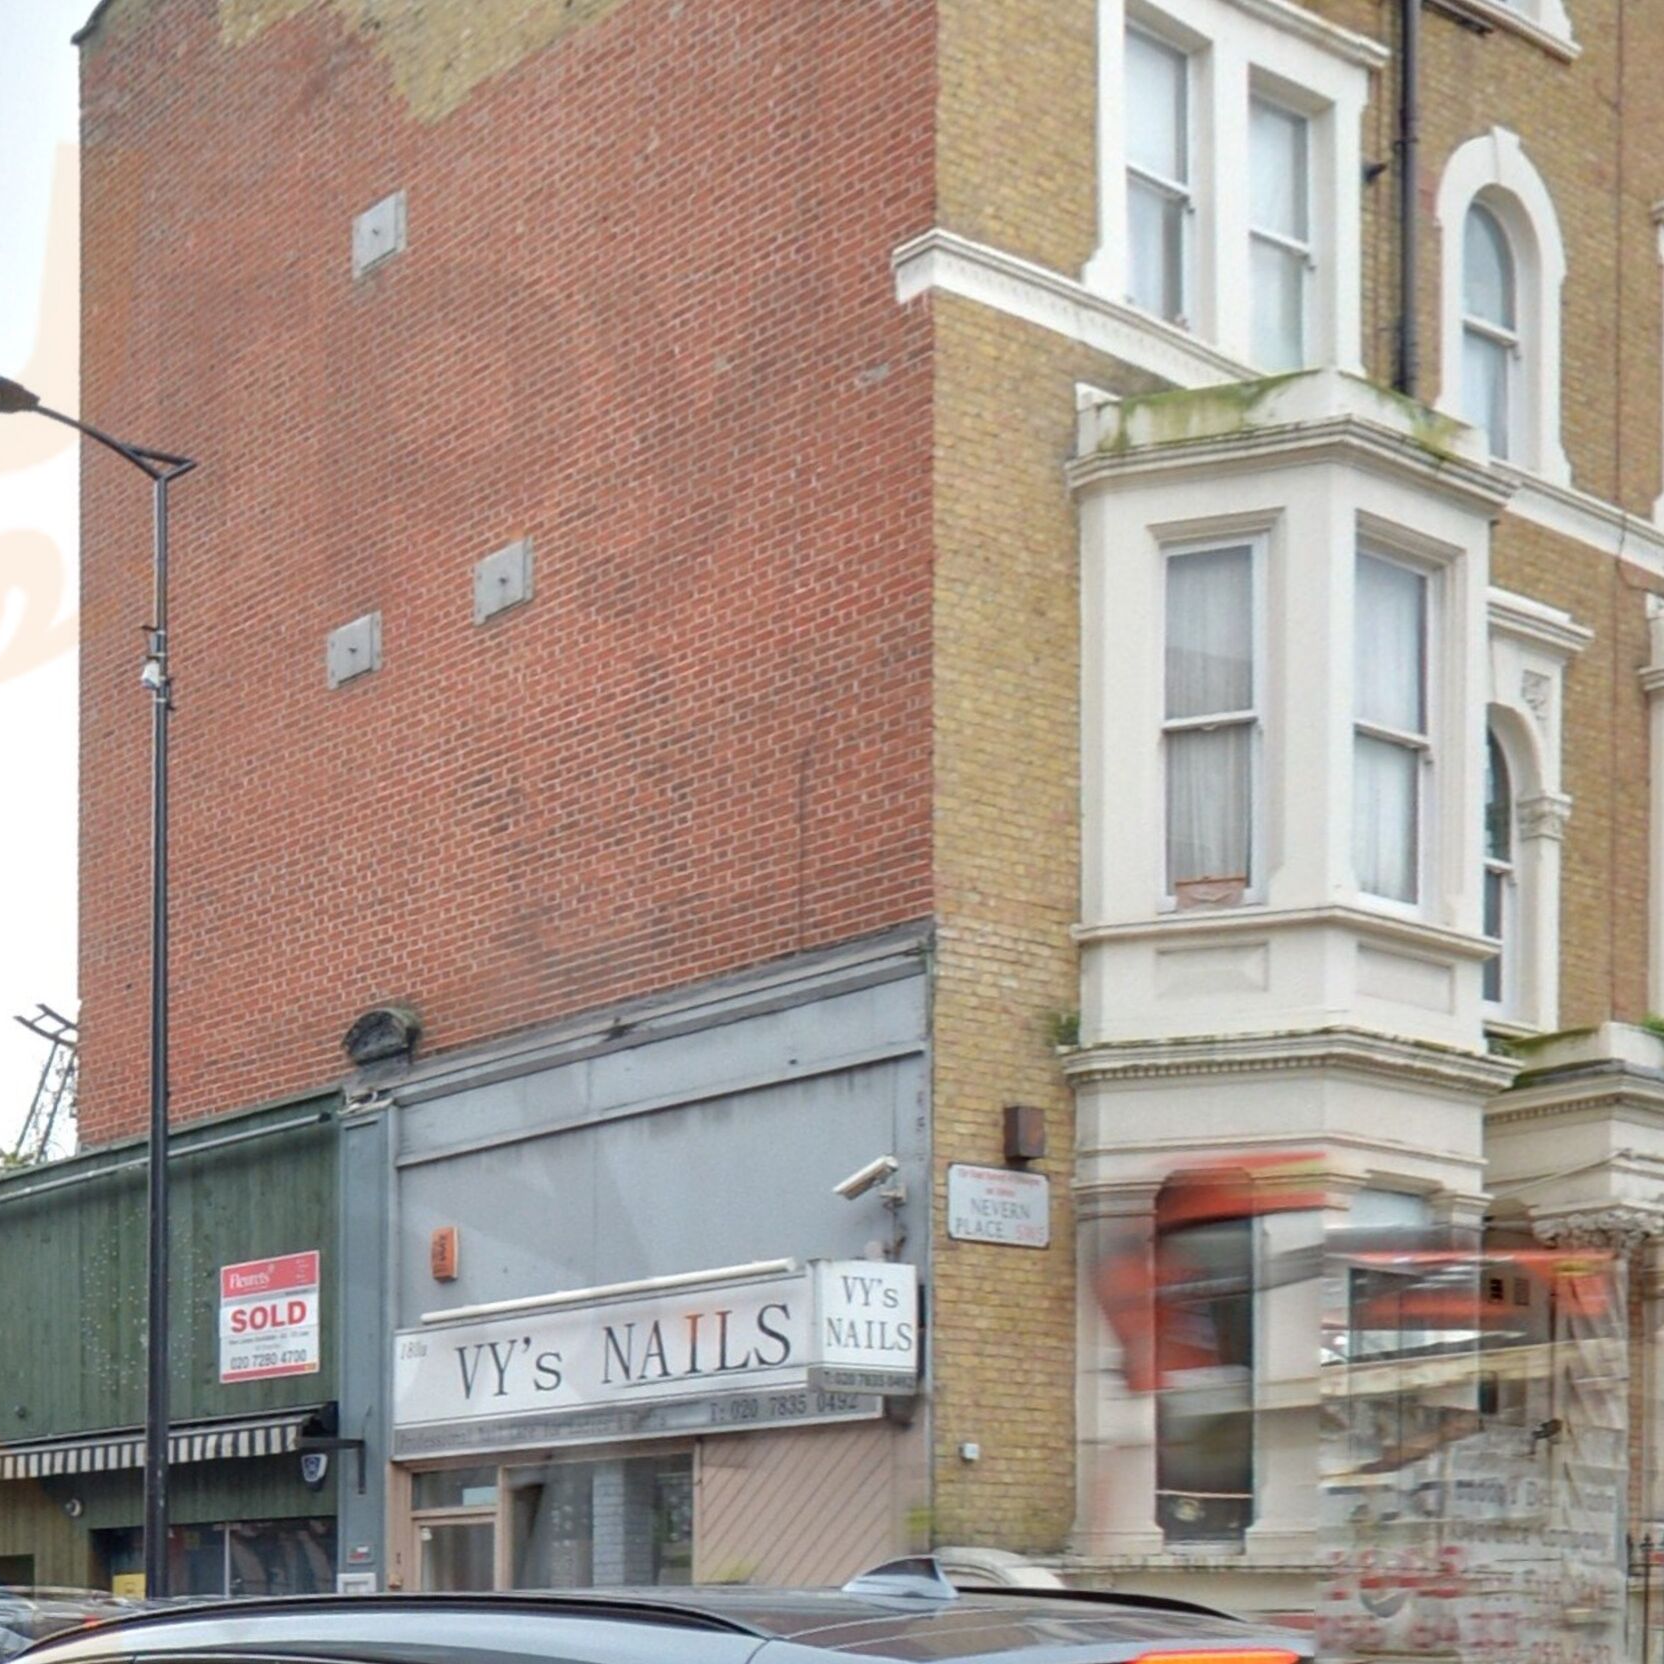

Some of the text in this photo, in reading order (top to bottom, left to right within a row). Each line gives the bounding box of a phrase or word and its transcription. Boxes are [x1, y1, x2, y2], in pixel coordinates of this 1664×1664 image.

[970, 1198, 1031, 1220] NEVERN
[955, 1217, 1004, 1239] PLACE
[840, 1275, 900, 1309] VY's
[230, 1300, 308, 1334] SOLD
[825, 1316, 914, 1352] NAILS
[454, 1302, 793, 1400] VY's NAILS
[769, 1396, 808, 1417] 7835
